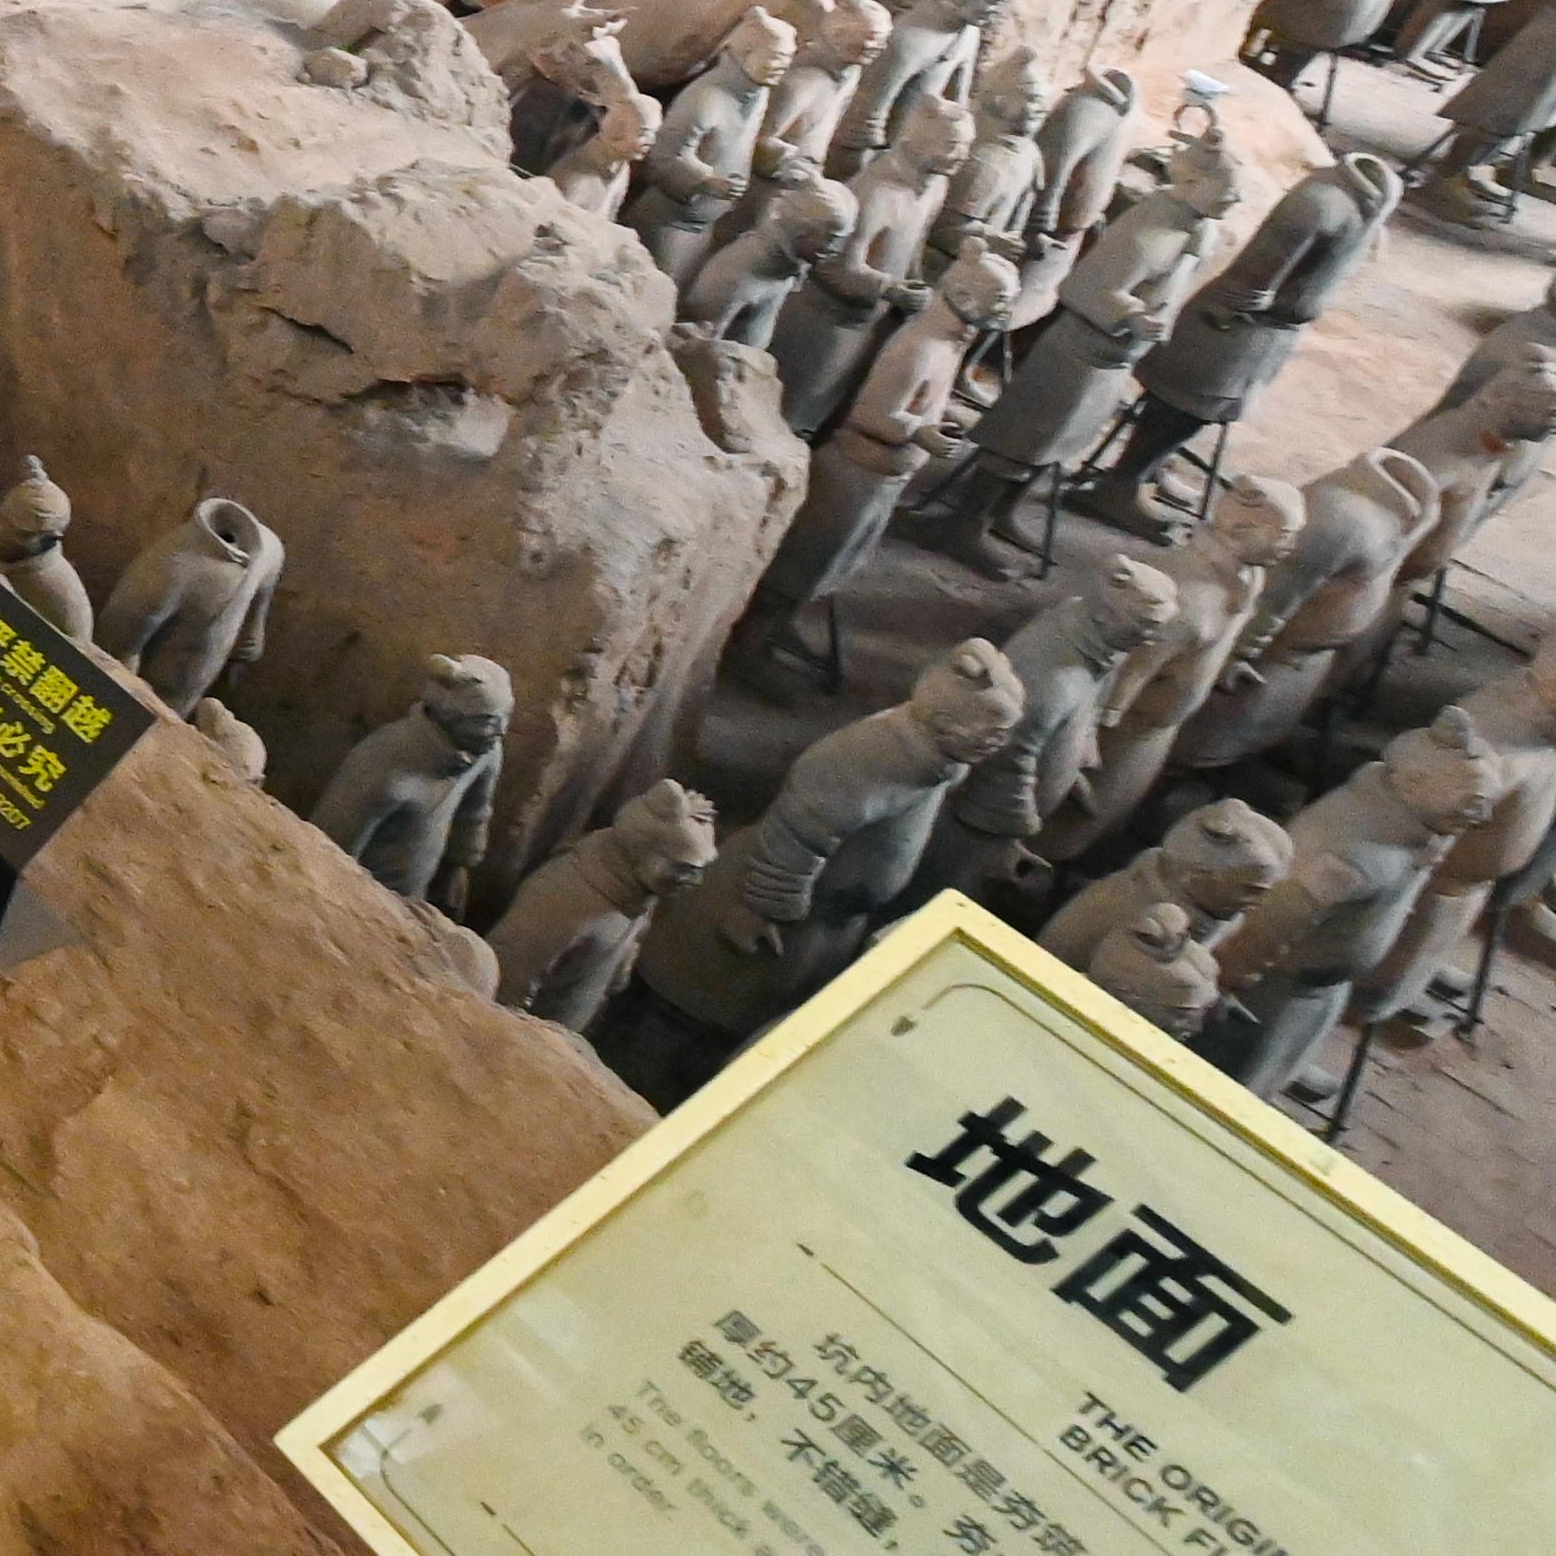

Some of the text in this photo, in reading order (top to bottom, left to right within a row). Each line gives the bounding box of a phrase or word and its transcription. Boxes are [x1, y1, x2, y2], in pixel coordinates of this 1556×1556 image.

[906, 1096, 1294, 1392] 地面
[607, 1405, 645, 1436] 45
[644, 1440, 682, 1476] cm
[637, 1380, 682, 1428] The
[687, 1428, 758, 1497] floors
[1059, 1425, 1186, 1528] BRICK
[1078, 1390, 1158, 1462] THE
